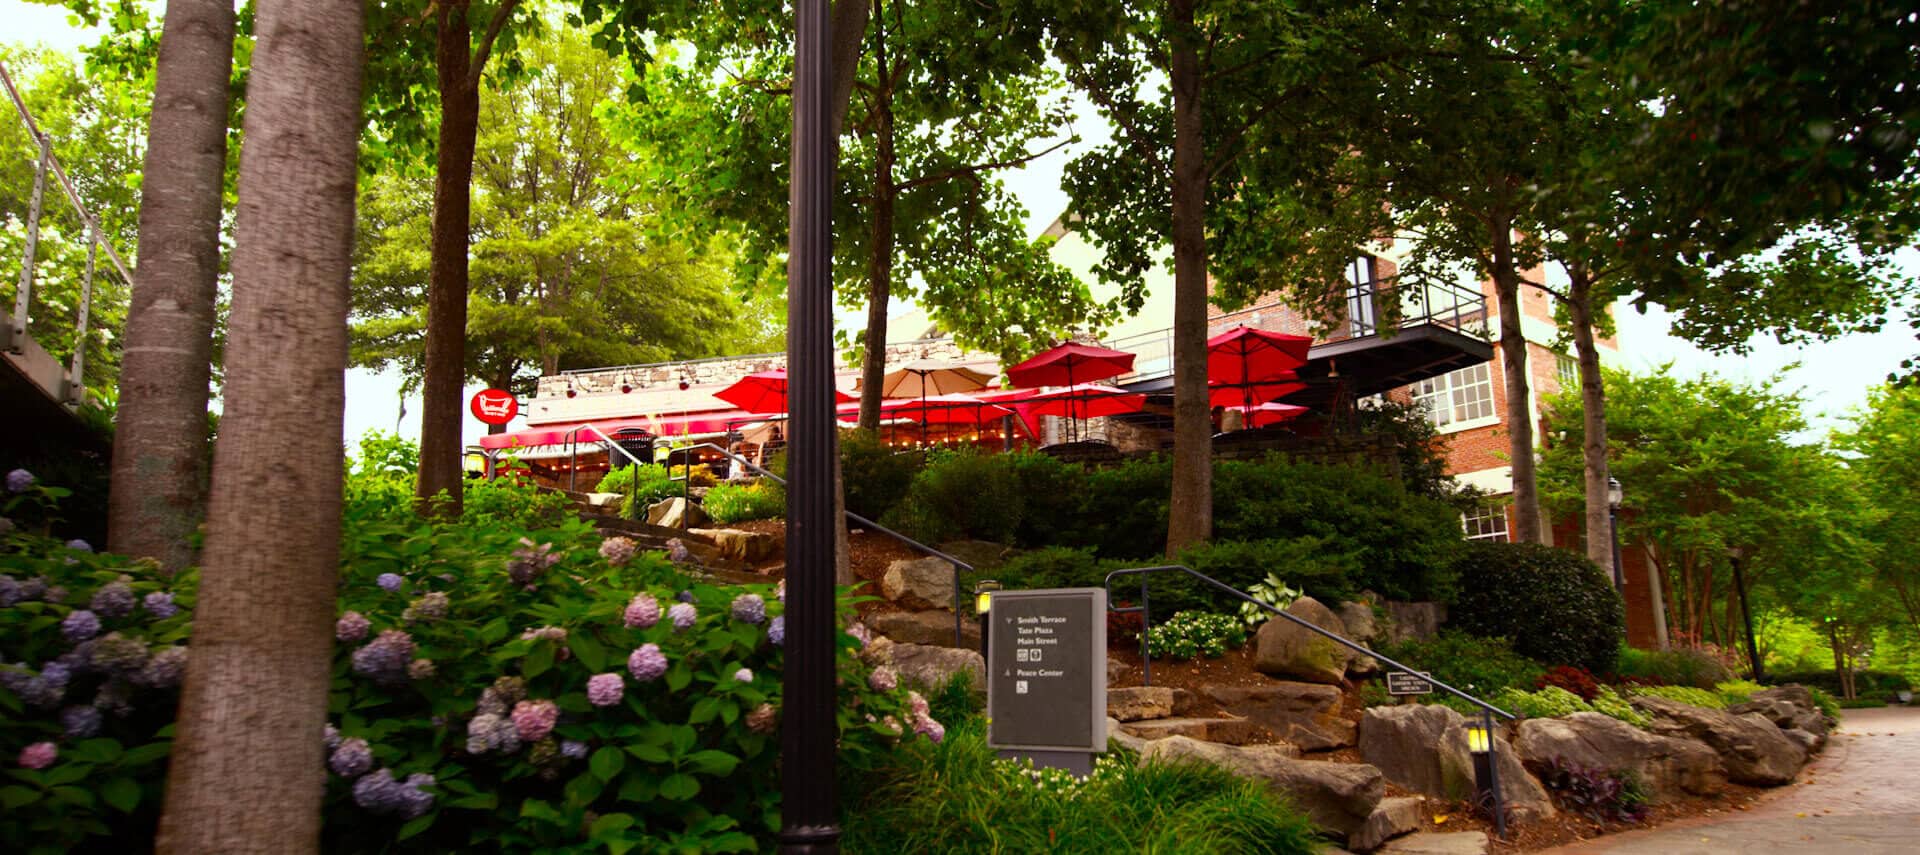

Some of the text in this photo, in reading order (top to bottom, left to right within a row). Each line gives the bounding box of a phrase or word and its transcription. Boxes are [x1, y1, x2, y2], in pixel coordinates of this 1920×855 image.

[1040, 615, 1067, 624] Terrace
[1034, 626, 1053, 634] Plaza
[1035, 637, 1058, 645] Street
[1017, 669, 1064, 677] Peace Center
